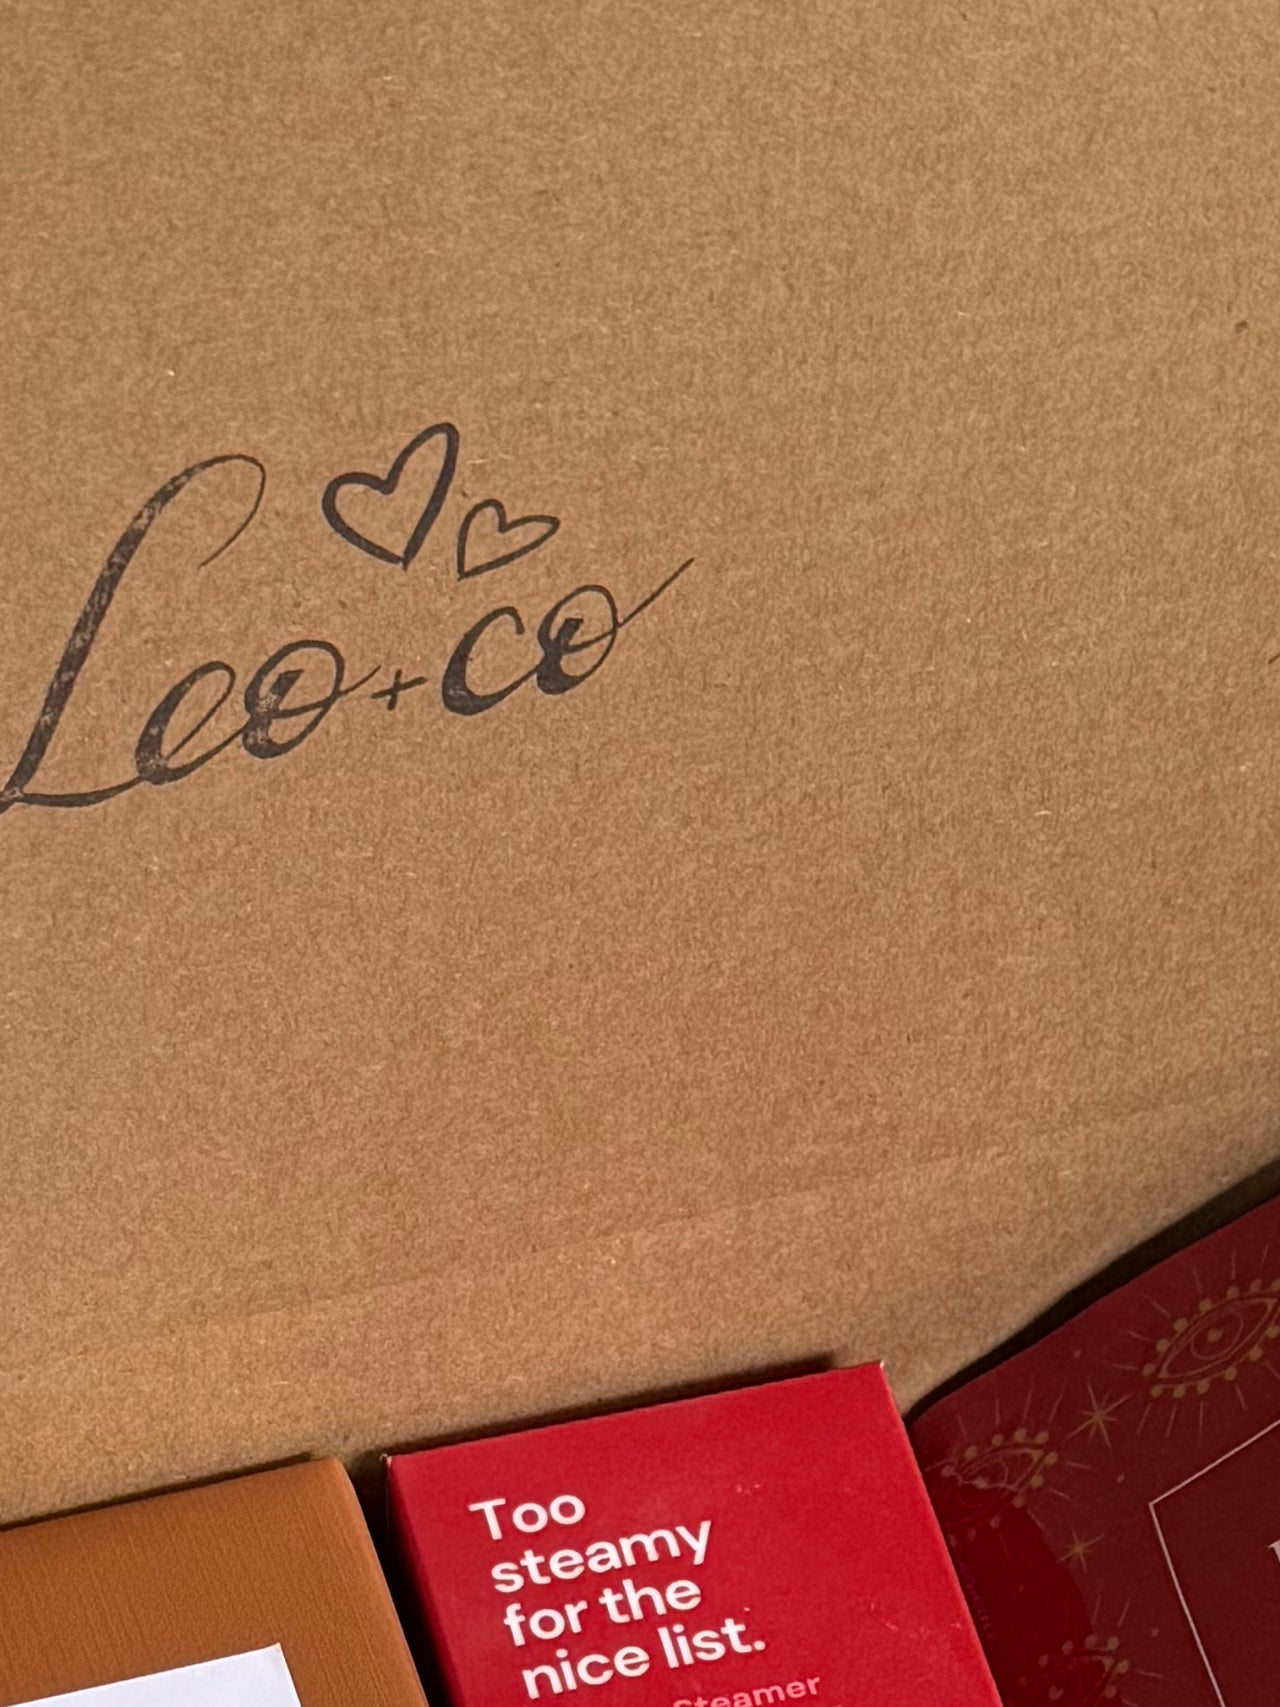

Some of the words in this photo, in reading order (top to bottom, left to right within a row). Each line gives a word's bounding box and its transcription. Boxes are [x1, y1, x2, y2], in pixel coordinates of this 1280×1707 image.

[469, 1494, 586, 1541] Too
[490, 1519, 713, 1594] steamy
[504, 1598, 589, 1646] for
[598, 1578, 702, 1625] the
[521, 1646, 650, 1699] nice
[658, 1615, 765, 1668] list.
